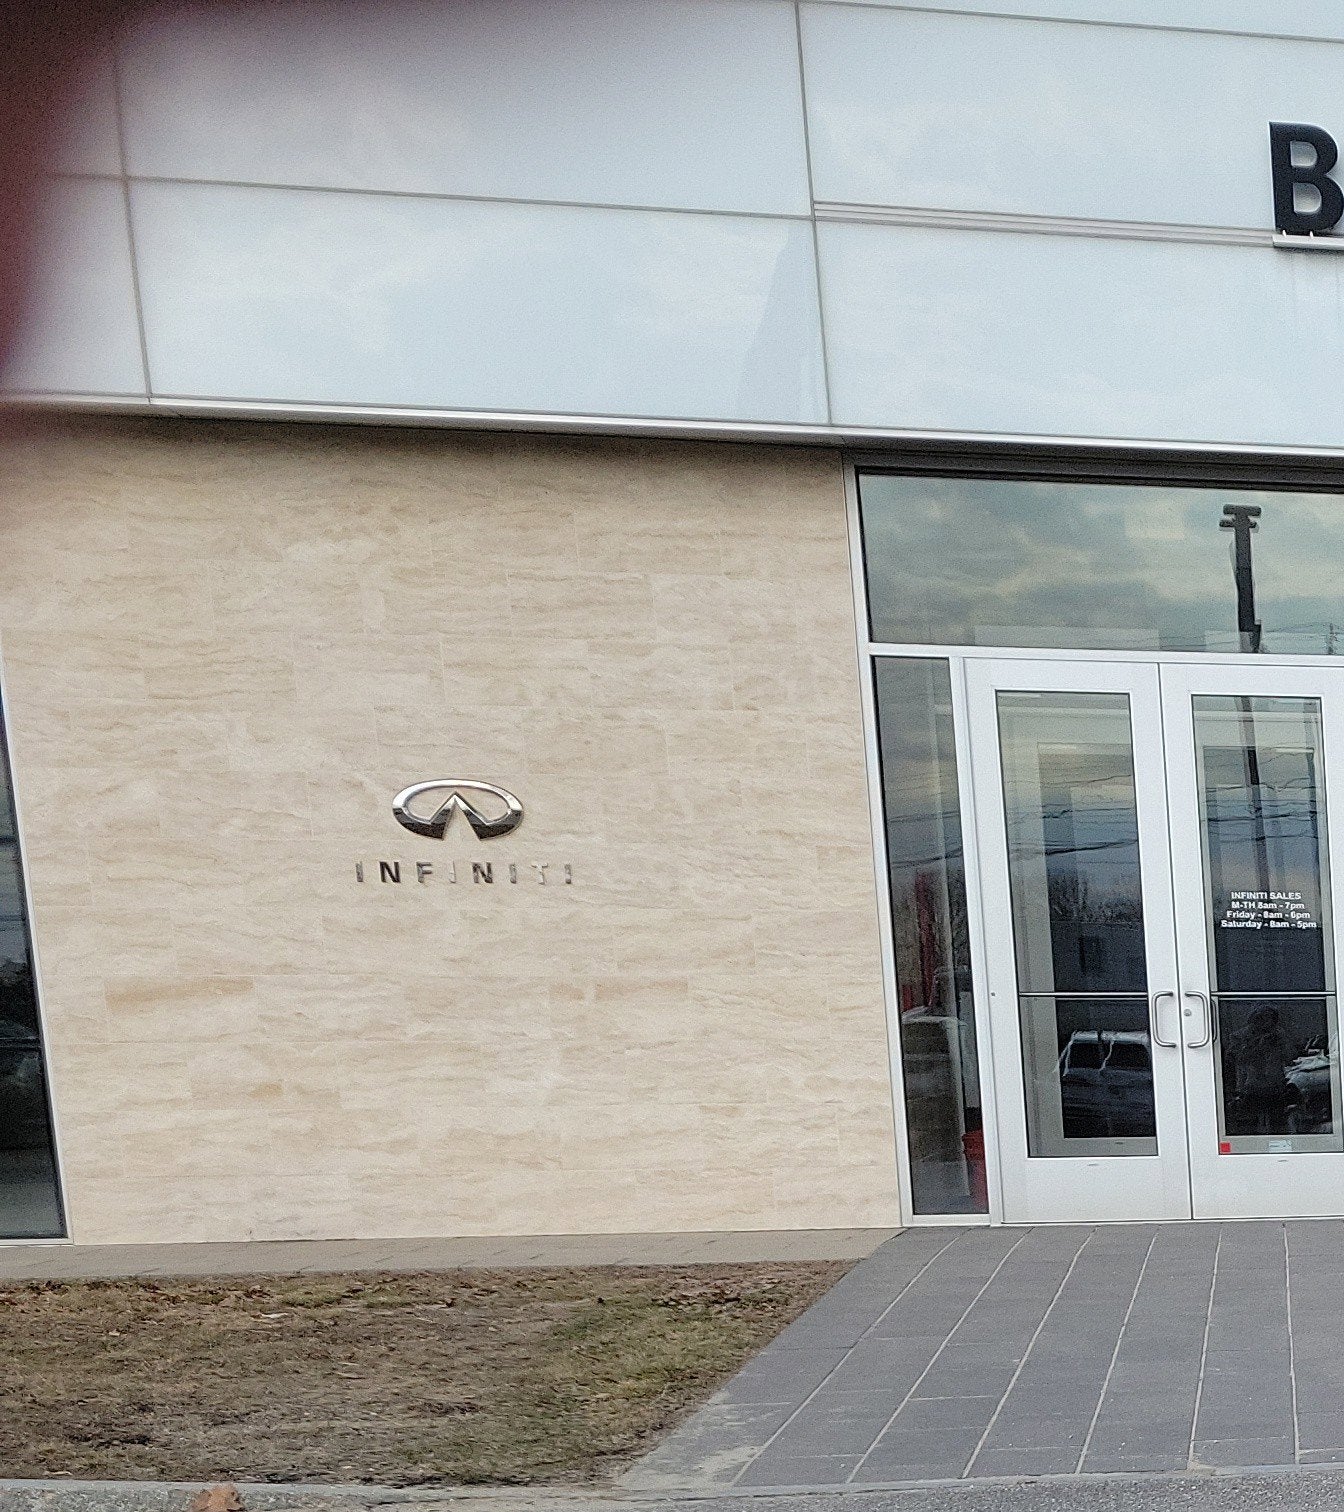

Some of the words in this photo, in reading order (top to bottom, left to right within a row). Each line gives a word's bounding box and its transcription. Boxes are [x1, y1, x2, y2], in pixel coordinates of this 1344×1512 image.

[356, 861, 573, 885] INFINITI
[1269, 892, 1302, 900] SALES
[1231, 901, 1255, 909] M-TH
[1285, 902, 1305, 910] 7pm
[1226, 910, 1256, 920] Friday
[1221, 920, 1262, 929] Saturday
